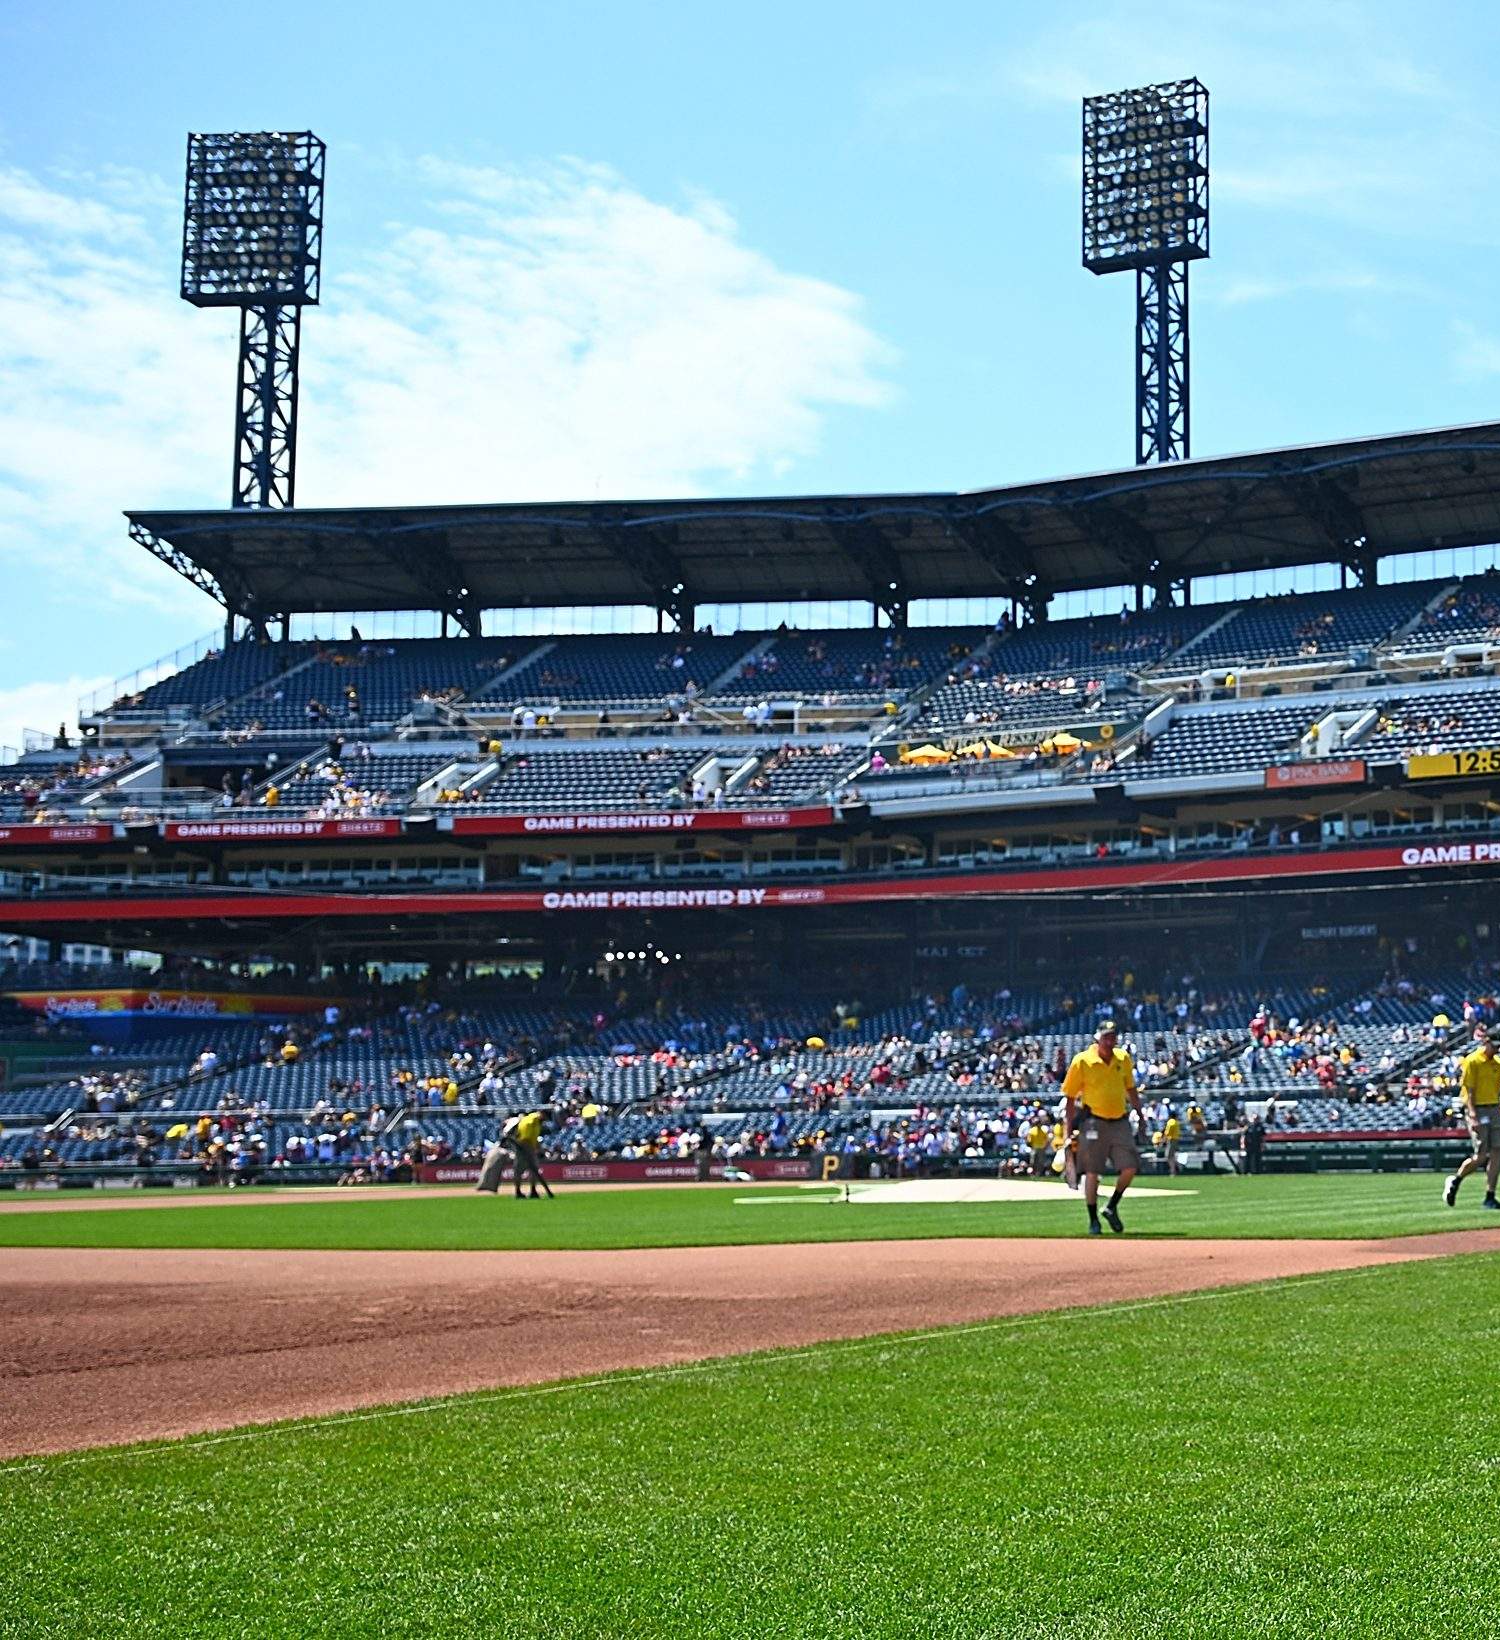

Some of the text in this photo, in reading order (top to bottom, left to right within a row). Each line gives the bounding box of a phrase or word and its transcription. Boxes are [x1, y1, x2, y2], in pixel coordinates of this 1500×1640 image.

[177, 822, 324, 837] GAME PRESENTED BY
[524, 814, 696, 830] GAME PRESENTED BY
[1402, 845, 1471, 865] GAME
[543, 888, 766, 908] GAME PRESENTED BY
[823, 1155, 840, 1181] P
